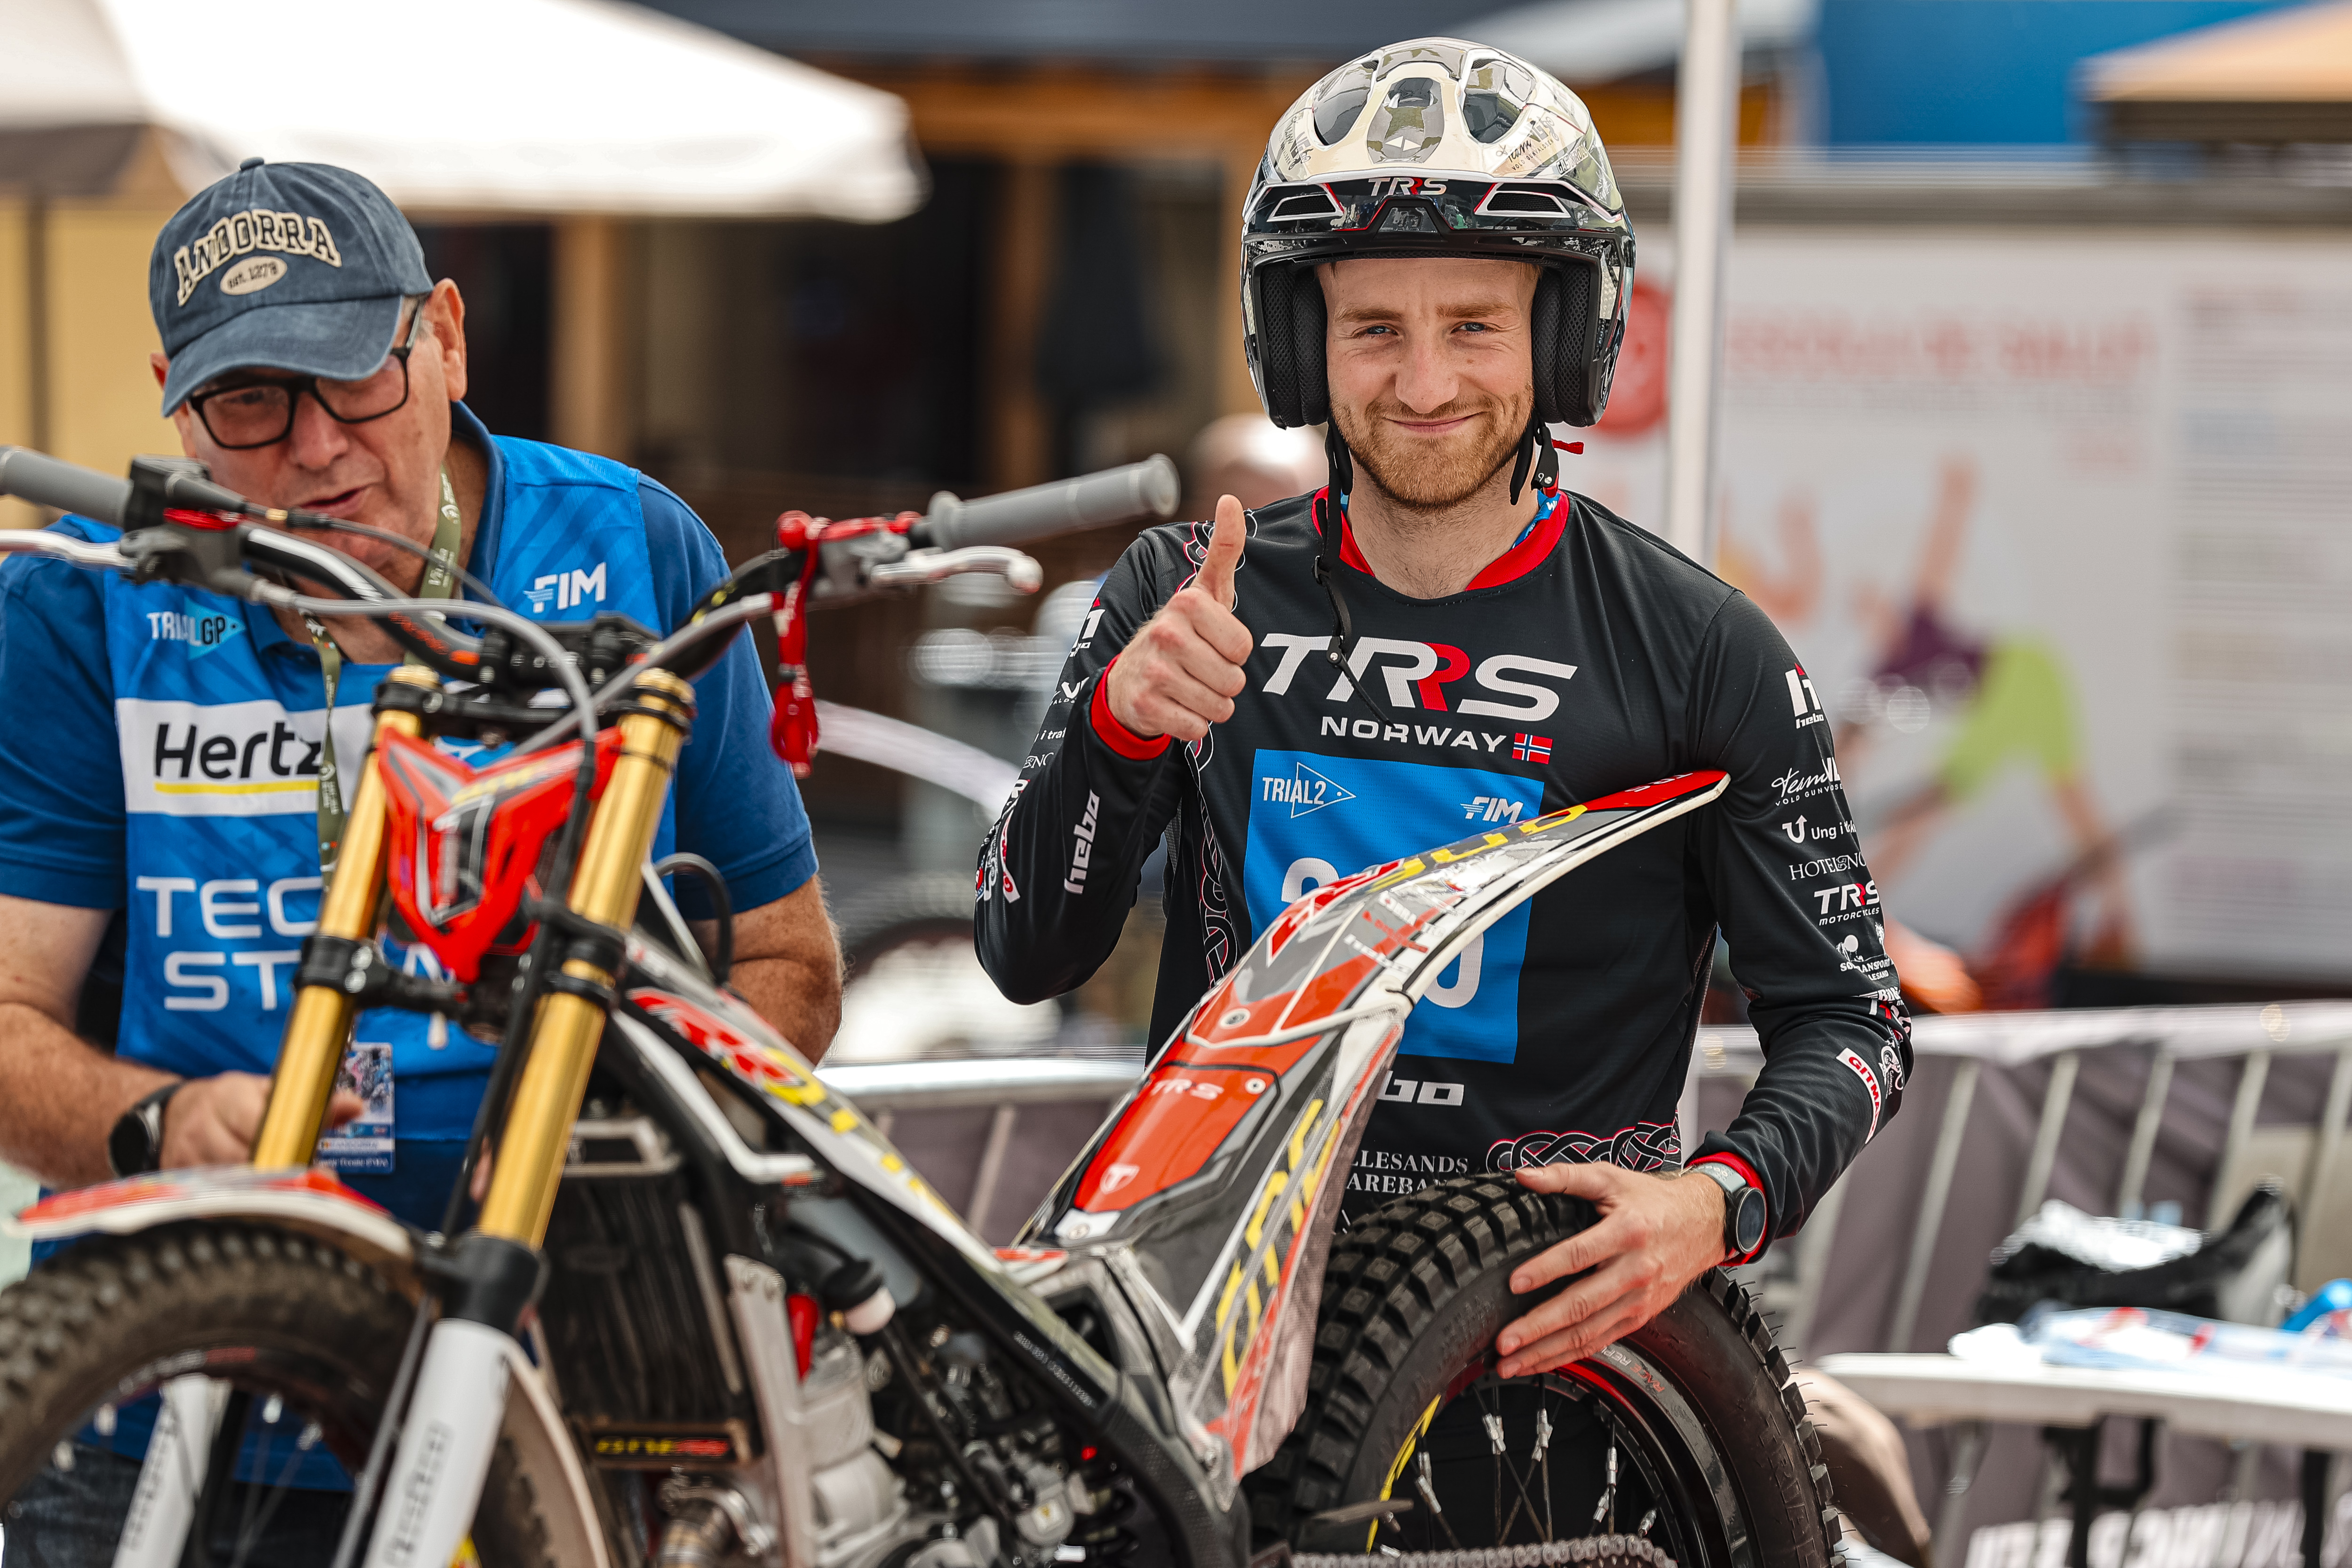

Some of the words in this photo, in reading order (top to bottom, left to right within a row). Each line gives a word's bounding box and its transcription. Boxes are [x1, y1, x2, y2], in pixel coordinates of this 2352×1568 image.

[1368, 178, 1448, 196] TRS
[174, 208, 342, 307] ANDORRA
[523, 562, 607, 613] FIM
[1260, 633, 1578, 722] TRS
[1320, 716, 1507, 753] NORWAY
[1796, 713, 1824, 729] hebo
[154, 721, 321, 780] Hertz
[1262, 777, 1327, 805] TRIAL2
[1460, 796, 1524, 824] FIM
[1775, 795, 1800, 806] VOLD
[1064, 789, 1100, 894] hebo
[1811, 827, 1837, 840] Ung
[1839, 822, 1844, 835] i
[1788, 858, 1840, 880] HOTEL
[136, 876, 323, 939] TEC
[1814, 880, 1880, 915] TRS
[1868, 970, 1889, 981] LESAND
[1377, 1070, 1464, 1106] bo
[1352, 1149, 1468, 1173] LESANDS
